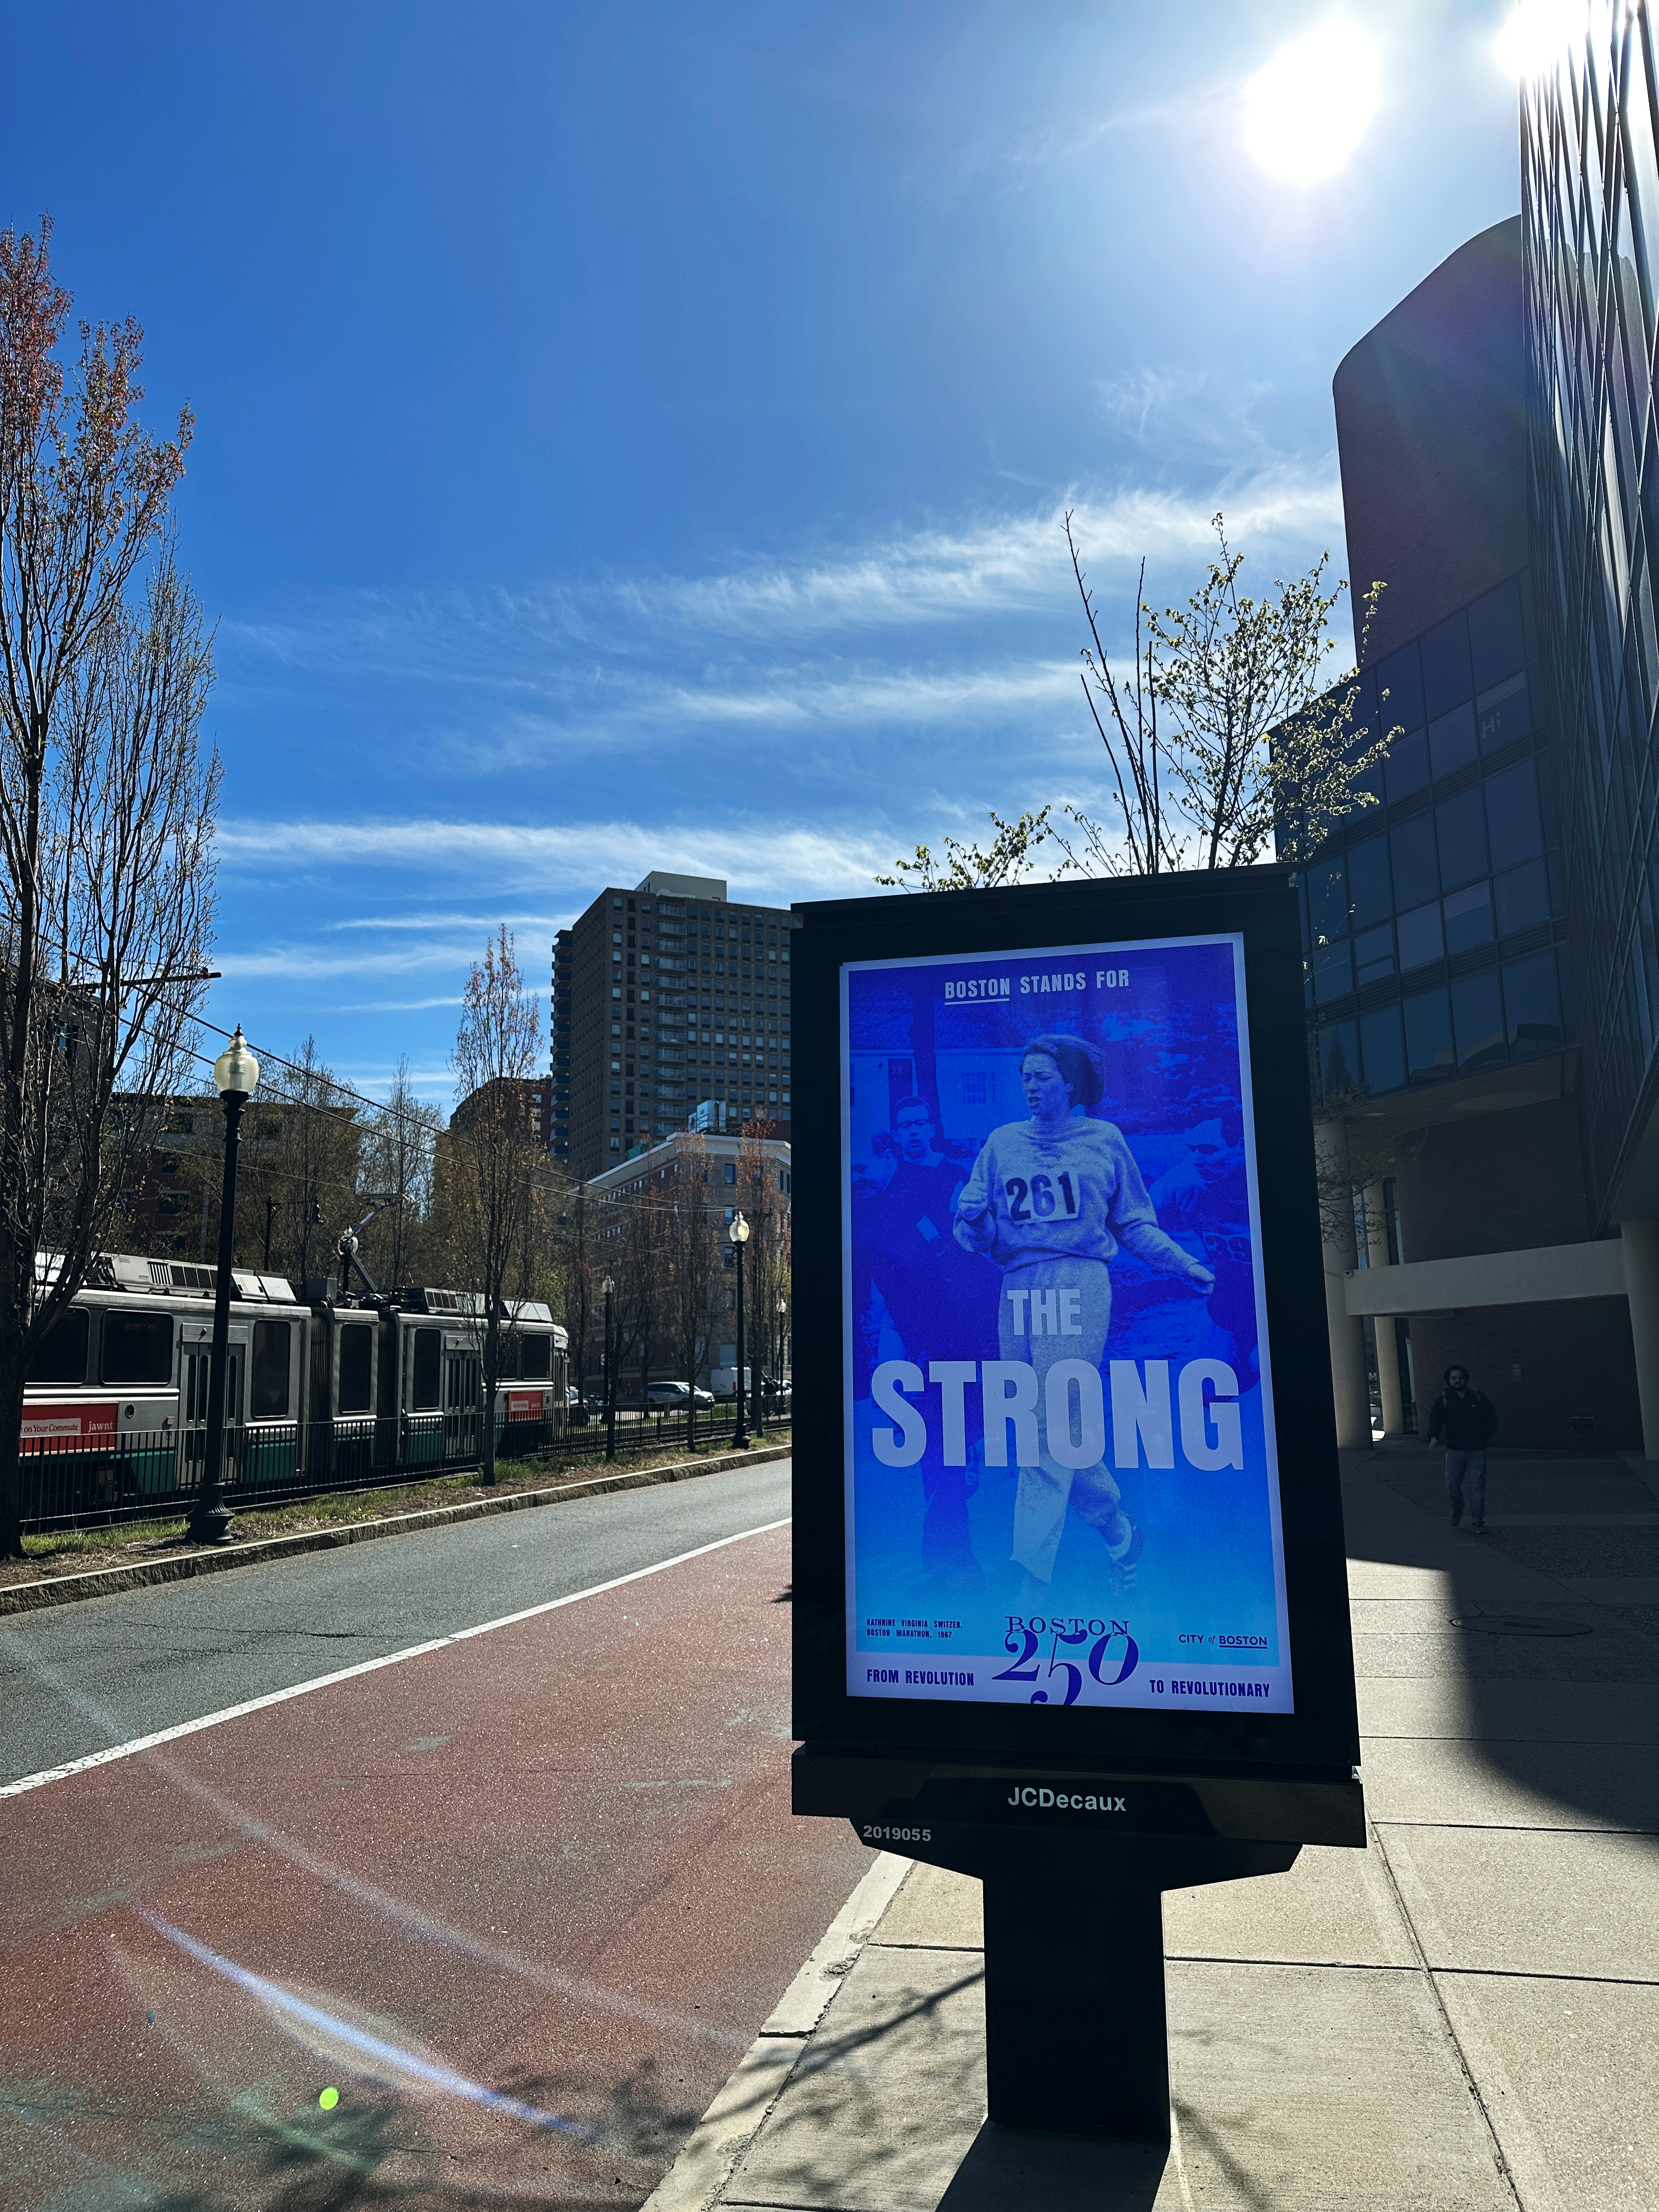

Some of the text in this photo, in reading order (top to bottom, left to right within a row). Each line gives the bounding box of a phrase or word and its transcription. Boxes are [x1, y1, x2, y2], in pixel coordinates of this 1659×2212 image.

[945, 969, 1129, 999] BOSTON STANDS FOR
[1005, 1170, 1077, 1222] 261
[1007, 1288, 1082, 1335] THE
[871, 1358, 1244, 1471] STRONG
[33, 1424, 49, 1433] Your
[49, 1424, 78, 1432] Commute
[88, 1420, 114, 1432] jawnt
[866, 1618, 963, 1629] KATHRINE VIRGINIA SWITZER,
[1005, 1616, 1130, 1636] BOSTON
[866, 1629, 952, 1639] BOSTON MARATHON, 1967
[1178, 1634, 1267, 1646] CITY of BOSTON
[992, 1629, 1139, 1706] 250
[866, 1669, 974, 1686] FROM REVOLUTION
[1149, 1679, 1270, 1697] TO REVOLUTIONARY
[1008, 1787, 1127, 1812] JCDecaux
[863, 1825, 932, 1842] 2019055
